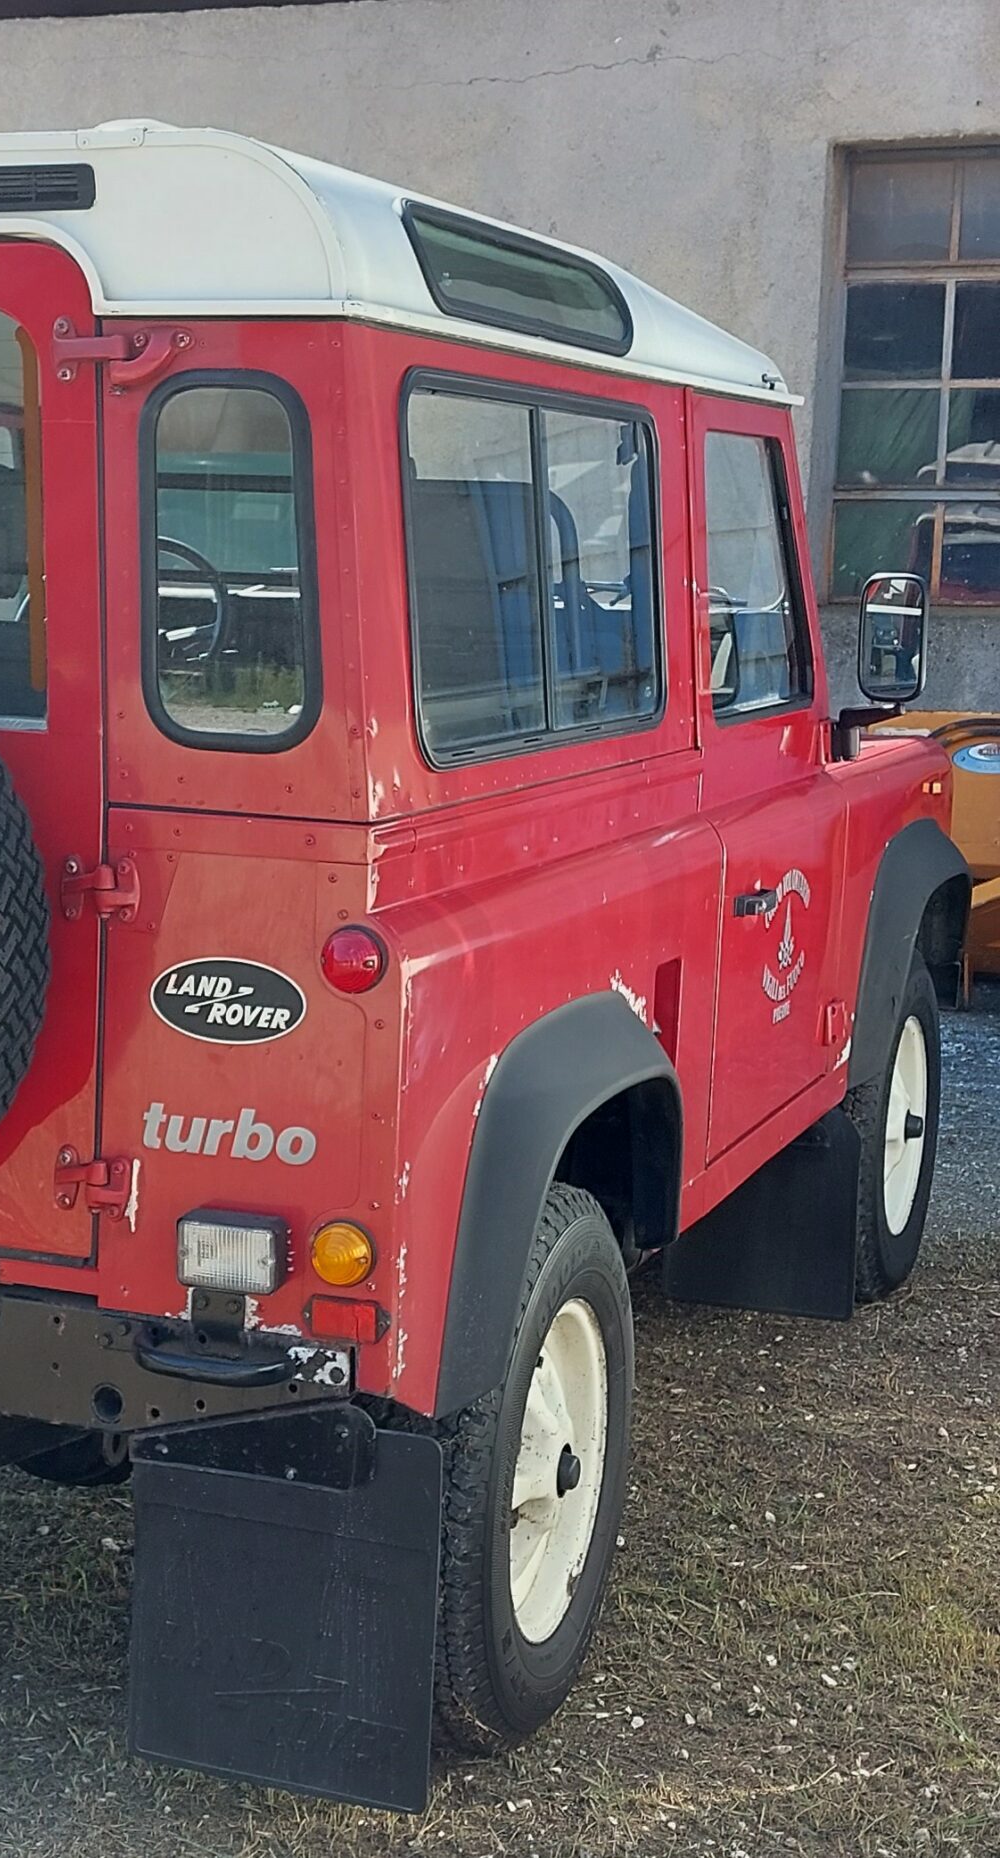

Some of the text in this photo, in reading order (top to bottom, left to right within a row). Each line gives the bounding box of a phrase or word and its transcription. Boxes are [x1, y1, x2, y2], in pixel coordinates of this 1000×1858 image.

[164, 973, 233, 998] LAND
[206, 1002, 292, 1030] ROVER
[142, 1101, 317, 1166] turbo
